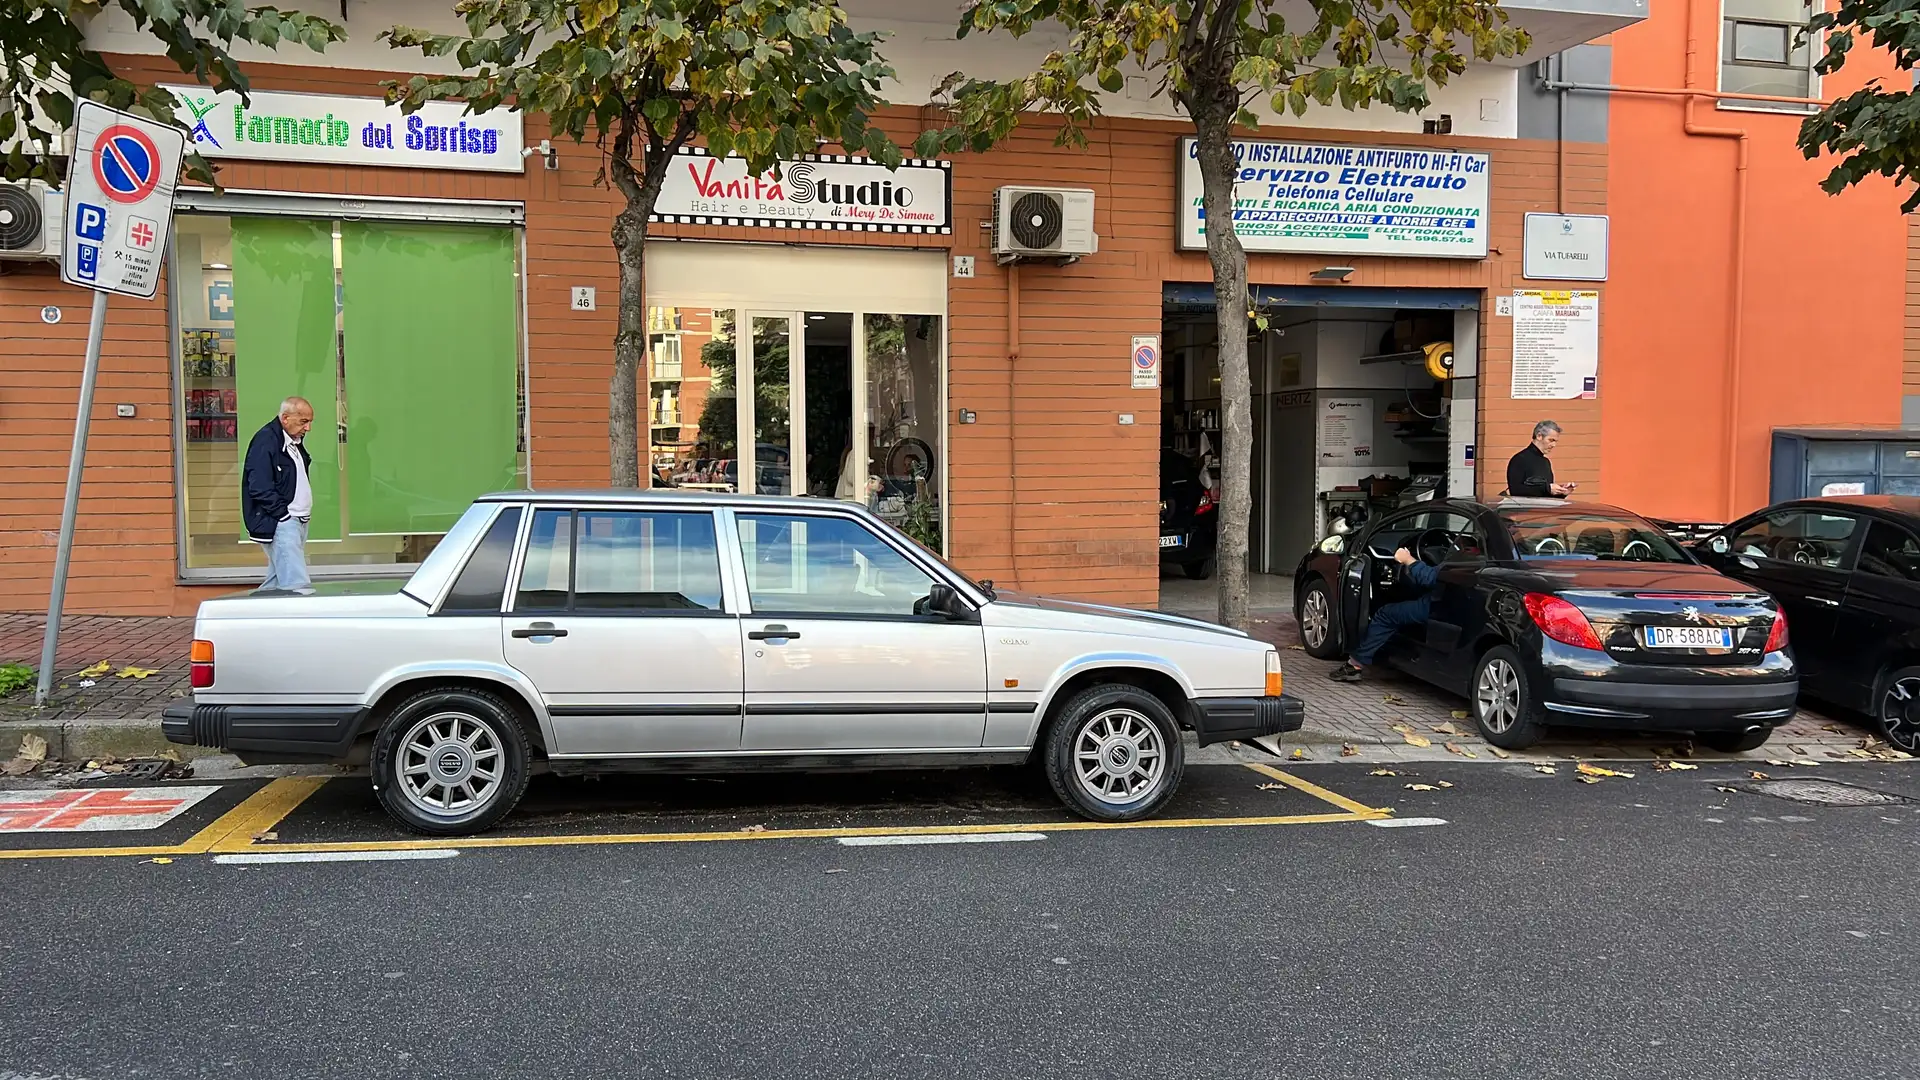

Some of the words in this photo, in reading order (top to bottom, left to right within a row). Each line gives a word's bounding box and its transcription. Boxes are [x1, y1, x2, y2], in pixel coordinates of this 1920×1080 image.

[1248, 144, 1353, 165] INSTALLAZIONE
[1356, 150, 1428, 170] ANTIFURTO
[1432, 154, 1462, 172] HI-FI
[1465, 156, 1486, 173] Car
[688, 158, 784, 201] Vanità
[788, 163, 913, 208] Studio
[1239, 168, 1330, 184] ervizio
[1338, 167, 1467, 190] Elettrauto
[1268, 184, 1339, 200] Telefonia
[1345, 187, 1414, 203] Cellulare
[691, 200, 729, 213] Hair
[740, 205, 748, 213] e
[759, 204, 815, 219] Beauty
[831, 206, 842, 217] di
[845, 207, 876, 221] Mery
[879, 208, 895, 219] De
[897, 210, 935, 221] Simone
[1261, 200, 1270, 208] E
[1274, 200, 1340, 211] RICARICA
[1344, 204, 1378, 213] ARIA
[1383, 205, 1480, 217] CONDIZIONATA
[81, 208, 100, 234] P
[1239, 211, 1374, 224] APPARECCHIATURE
[1377, 216, 1388, 224] A
[1391, 216, 1438, 226] NORME
[1442, 219, 1468, 228] CEE
[1285, 224, 1371, 232] ACCENSIONE
[1374, 228, 1463, 236] ELETTRONICA
[1415, 236, 1474, 244] 596.57.62
[125, 253, 132, 261] 15
[1544, 251, 1556, 259] VIA
[958, 267, 968, 275] 44
[577, 298, 590, 307] 46
[1500, 306, 1509, 314] 42
[1656, 628, 1674, 643] DR
[1680, 629, 1721, 645] 588AC
